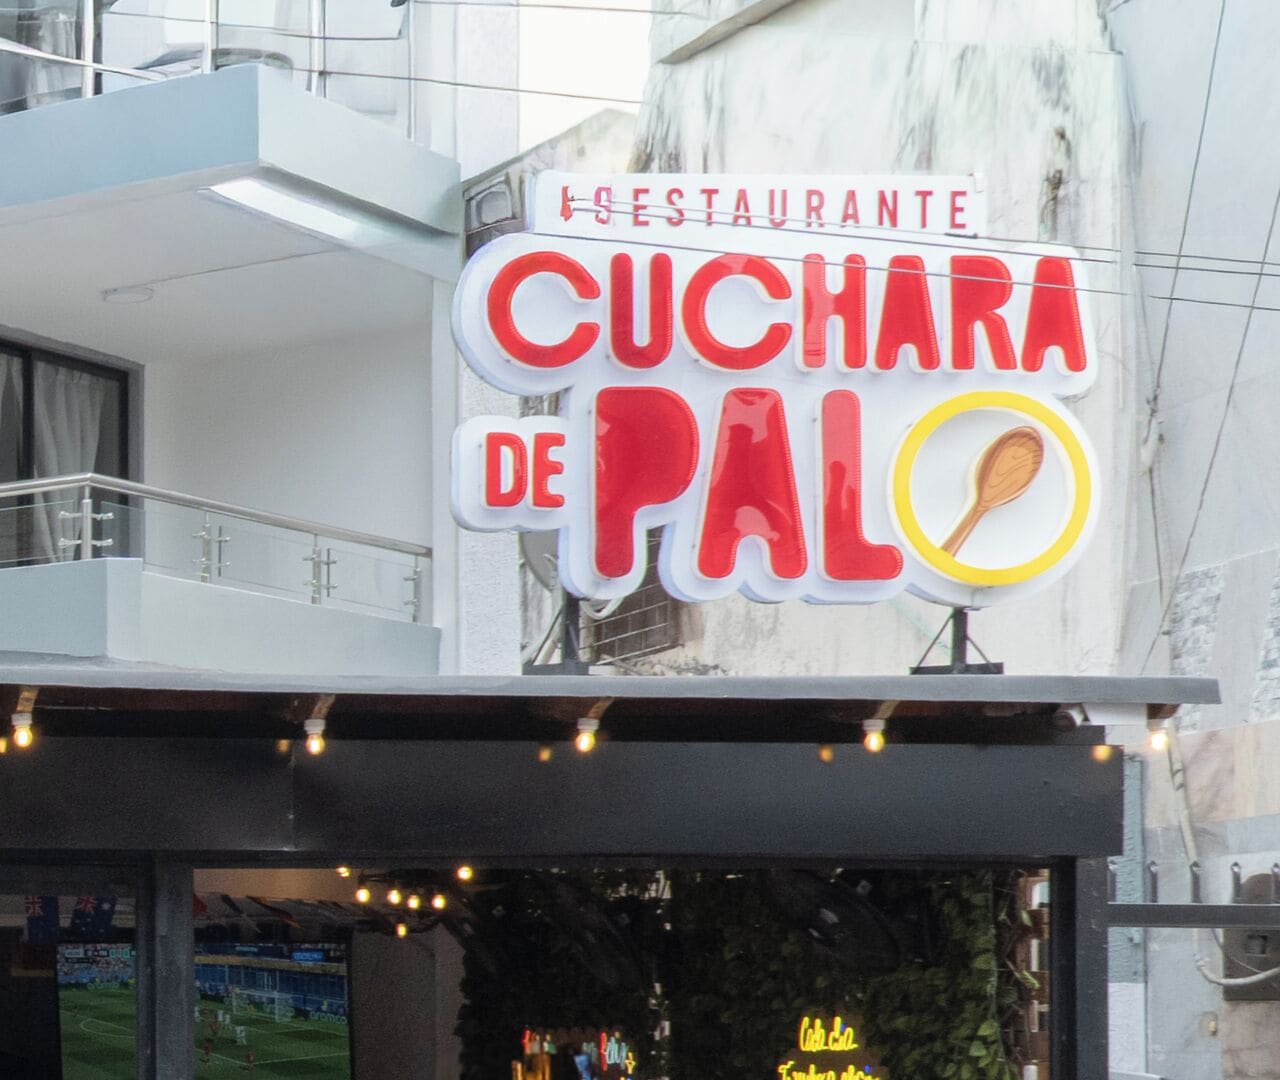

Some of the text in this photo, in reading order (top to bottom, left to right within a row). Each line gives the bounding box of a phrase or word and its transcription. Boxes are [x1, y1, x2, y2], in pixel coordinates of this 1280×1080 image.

[486, 250, 1087, 371] CUCHARA
[485, 386, 1092, 586] DE PALO
